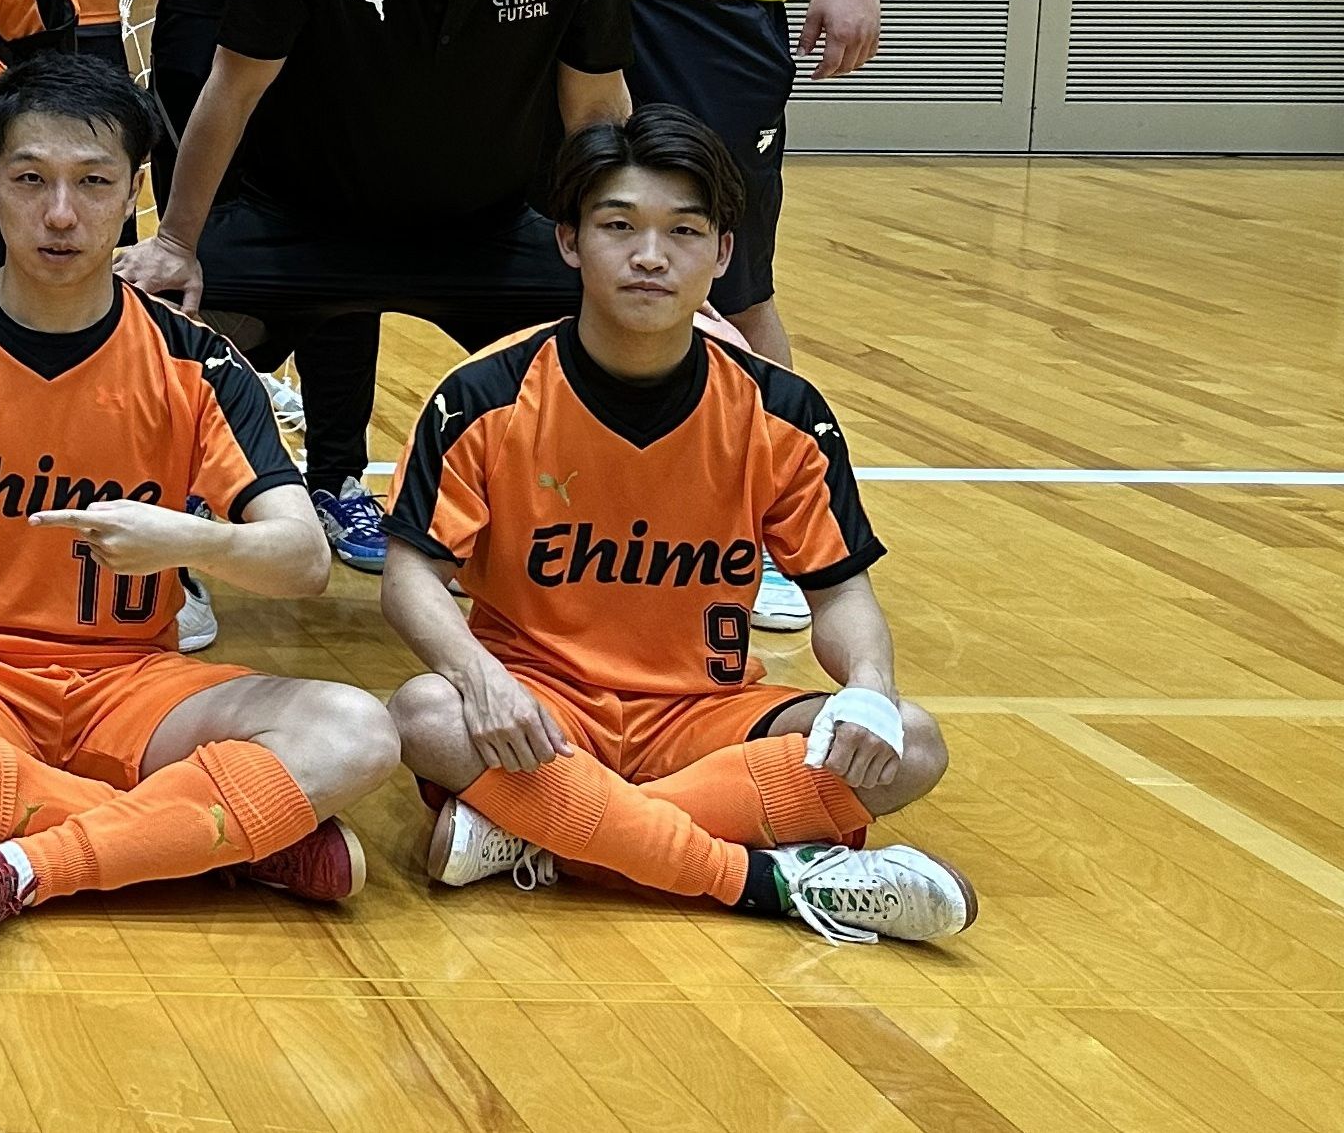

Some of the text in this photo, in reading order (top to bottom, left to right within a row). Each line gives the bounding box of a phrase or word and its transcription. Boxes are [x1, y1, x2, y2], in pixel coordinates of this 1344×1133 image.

[498, 2, 549, 23] FUTSAL
[72, 539, 161, 626] 10
[527, 519, 756, 588] Ehime
[703, 601, 751, 686] 9
